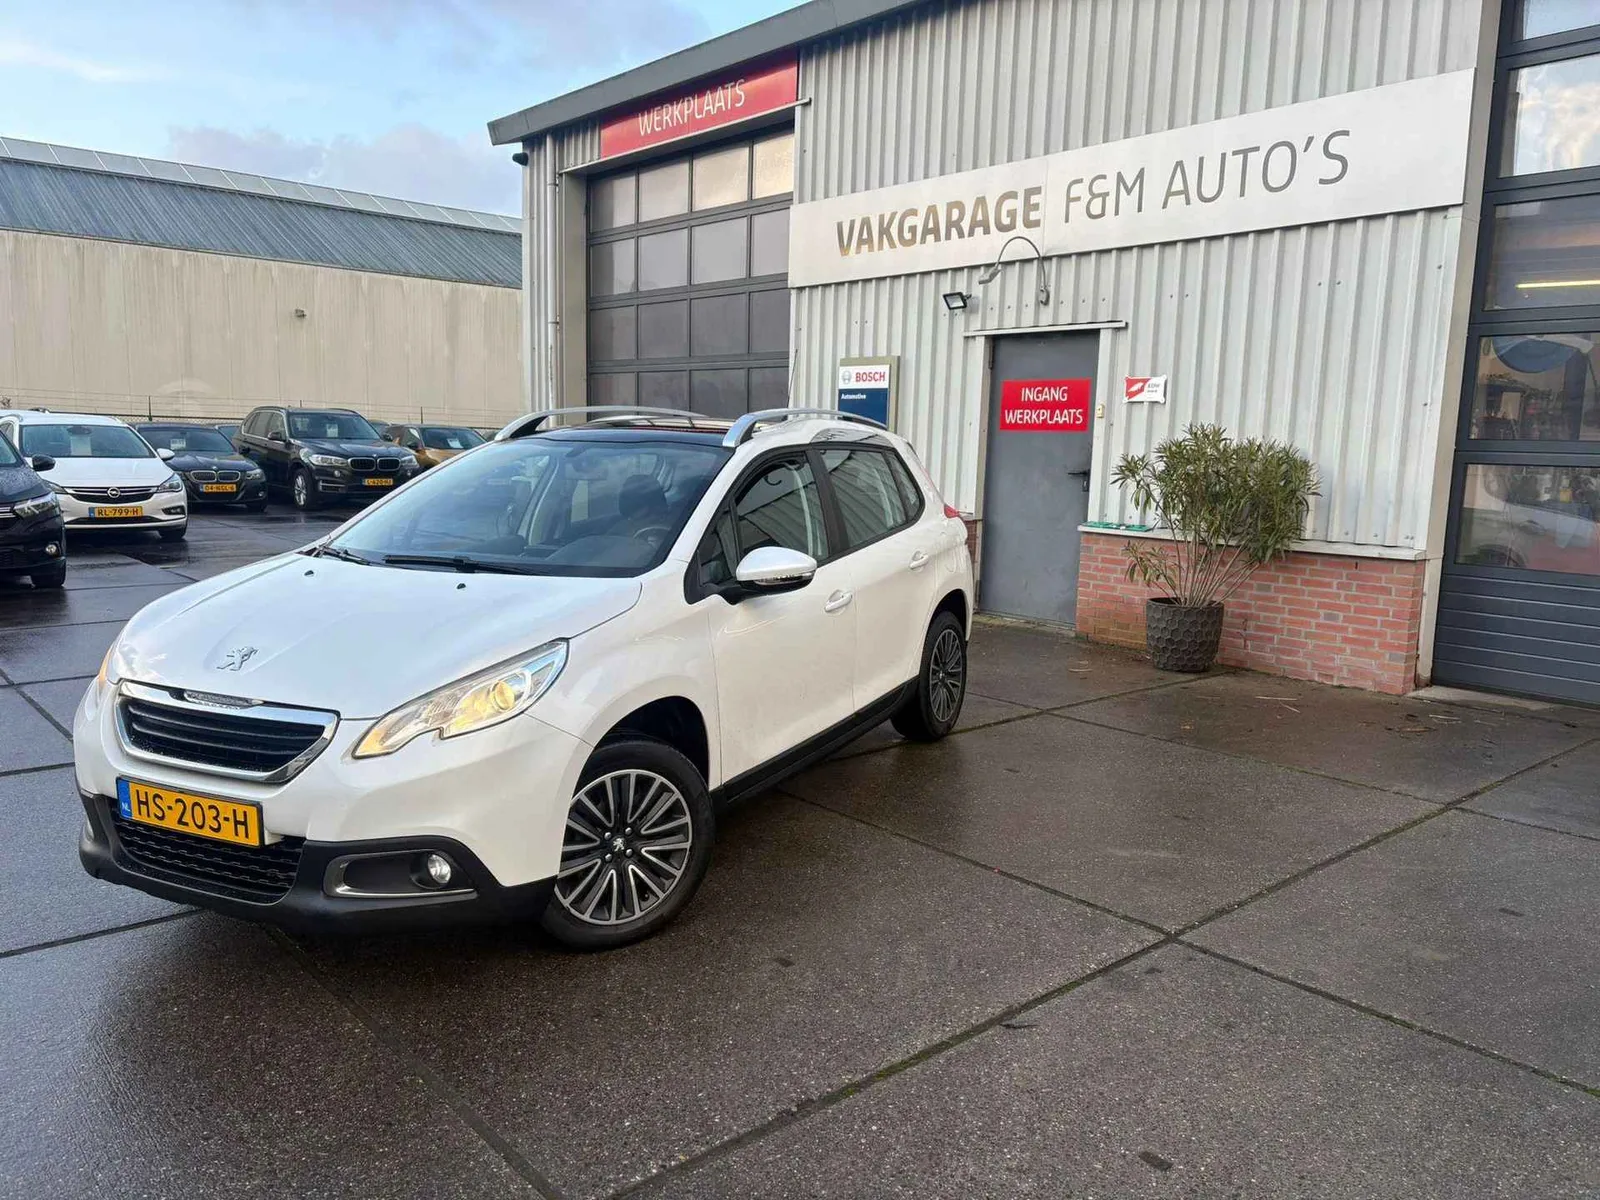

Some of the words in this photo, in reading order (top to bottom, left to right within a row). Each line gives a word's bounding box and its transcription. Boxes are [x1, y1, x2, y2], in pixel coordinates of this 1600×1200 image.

[637, 78, 746, 136] WERKPLAATS
[836, 185, 1043, 258] VAKGARAGE
[1064, 166, 1146, 224] F&M
[1161, 129, 1351, 211] AUTO'S
[855, 371, 886, 383] BOSCH
[1021, 386, 1069, 402] INGANG
[1004, 408, 1084, 425] WERKPLAATS
[97, 507, 140, 517] RL-799-H
[135, 789, 250, 839] HS-203-H
